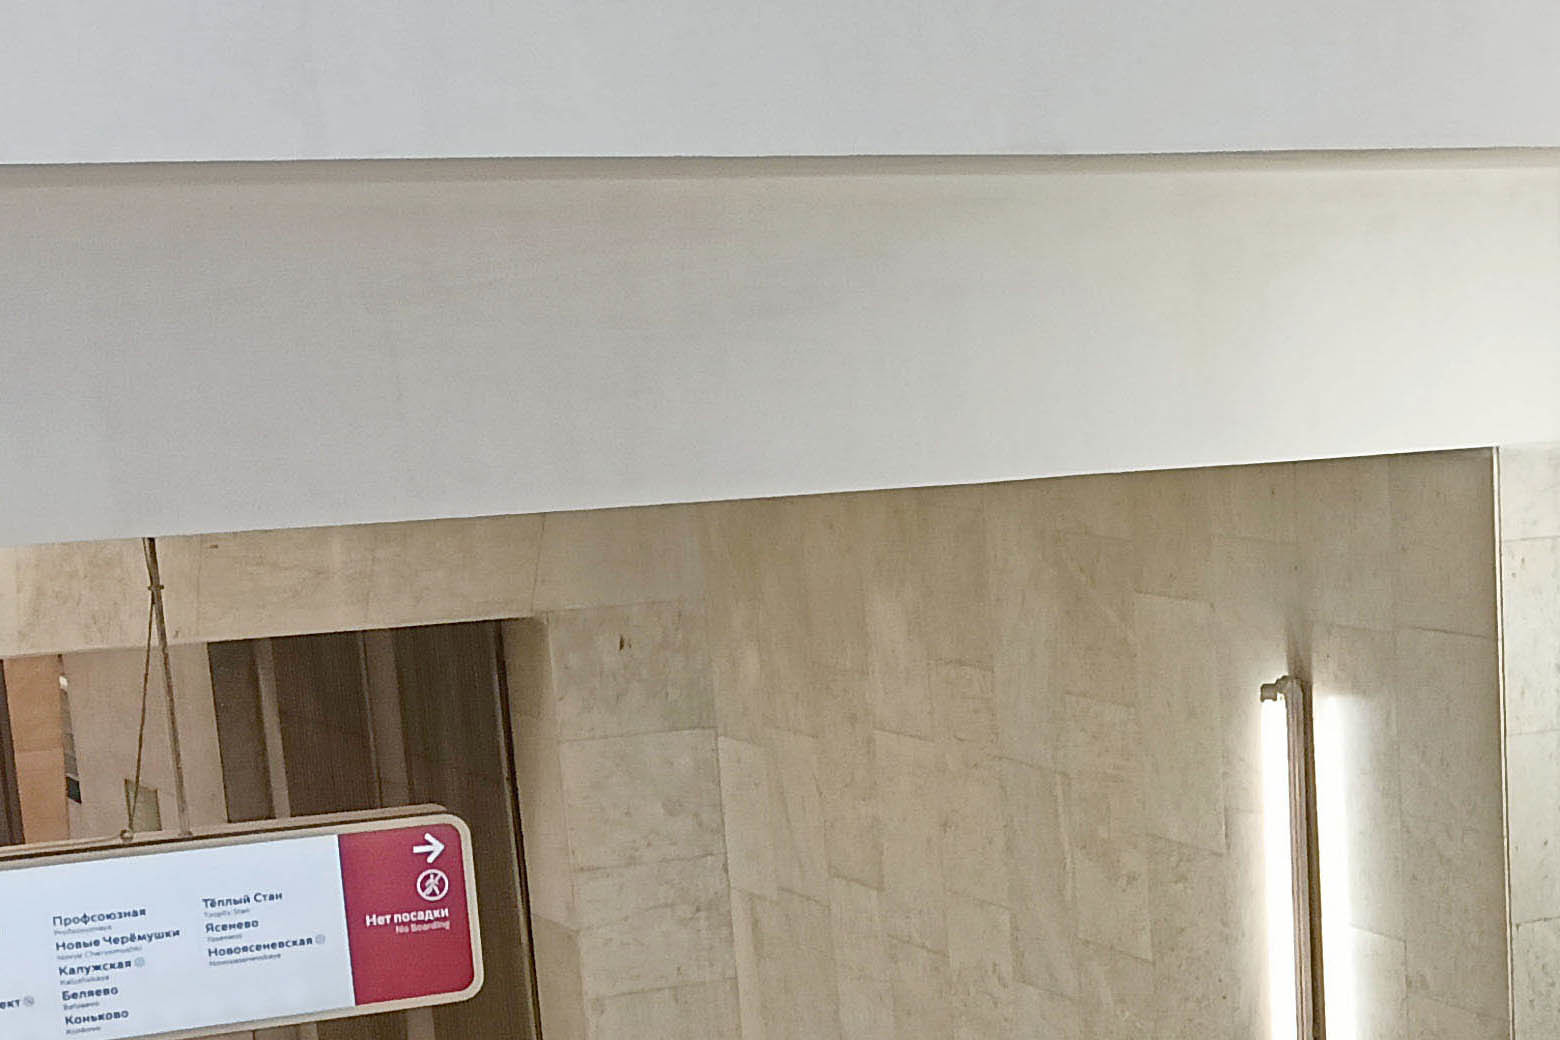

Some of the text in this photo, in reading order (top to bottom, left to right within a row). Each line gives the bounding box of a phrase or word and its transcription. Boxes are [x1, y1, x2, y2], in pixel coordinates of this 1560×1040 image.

[202, 892, 283, 909] Тёплый Стан
[52, 908, 146, 927] Профсоюзная
[365, 908, 449, 927] Нет посадки
[205, 920, 259, 934] Ясенево
[55, 938, 101, 951] Новые
[102, 929, 180, 946] Черёмушки
[208, 937, 313, 957] Новоясеневская
[58, 960, 132, 976] Калужская
[62, 986, 119, 1001] Беляево
[65, 1010, 129, 1025] Коньково
